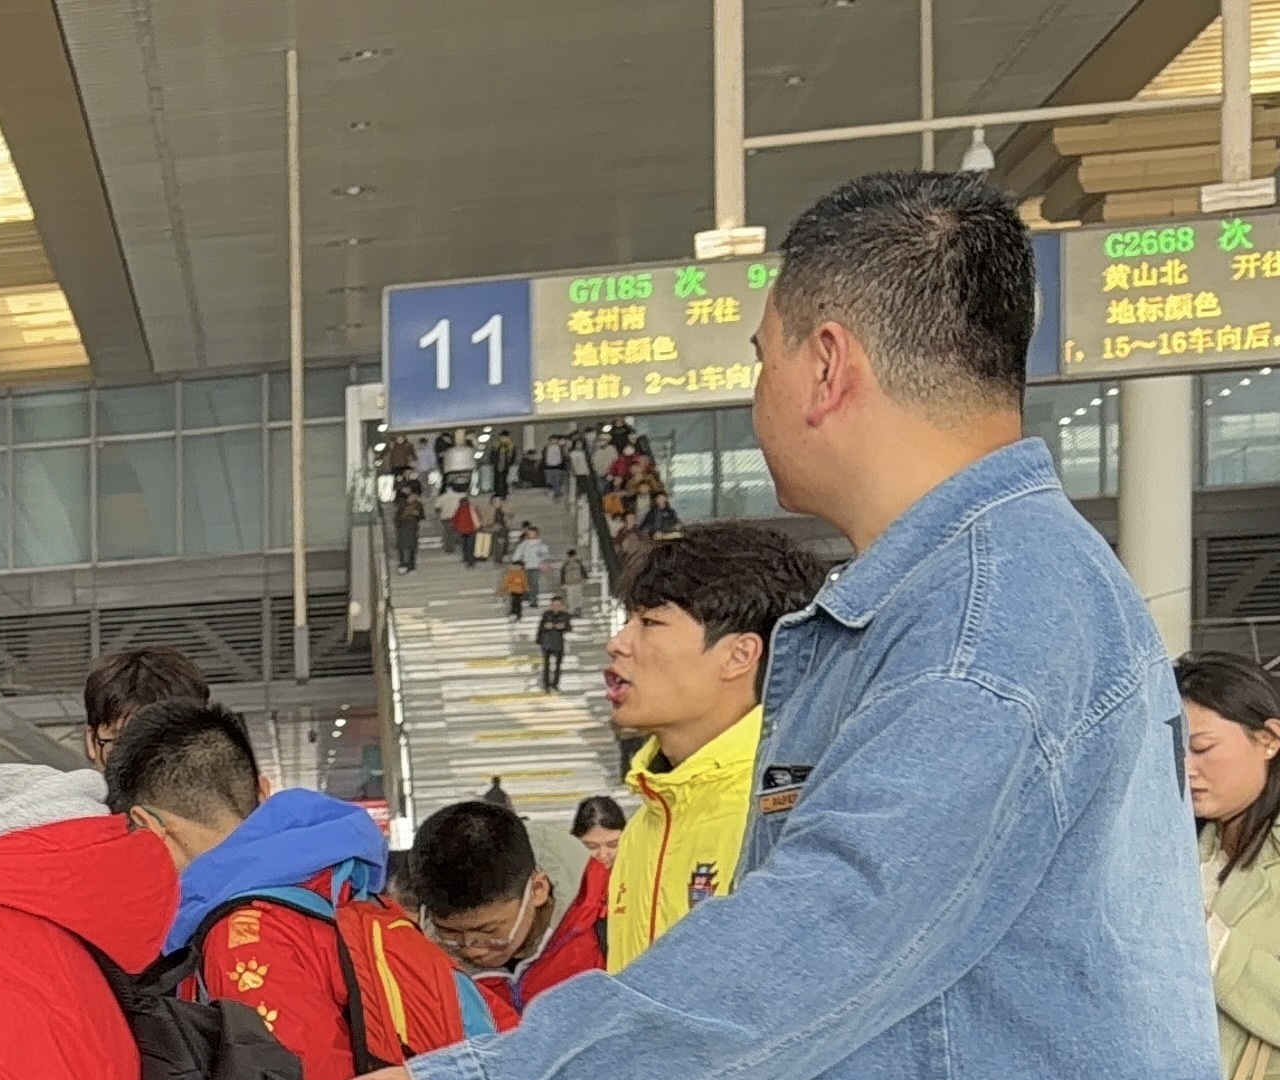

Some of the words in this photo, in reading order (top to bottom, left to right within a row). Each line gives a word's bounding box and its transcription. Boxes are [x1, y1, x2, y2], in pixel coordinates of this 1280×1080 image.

[1104, 226, 1196, 258] G2668
[1219, 218, 1253, 252] 次
[568, 272, 653, 304] G7185
[673, 265, 708, 297] 次
[1102, 258, 1189, 292] 黄山北
[685, 297, 741, 326] 开往
[1106, 291, 1222, 325] 地标颜色
[419, 313, 503, 390] 11
[571, 336, 679, 368] 地标颜色
